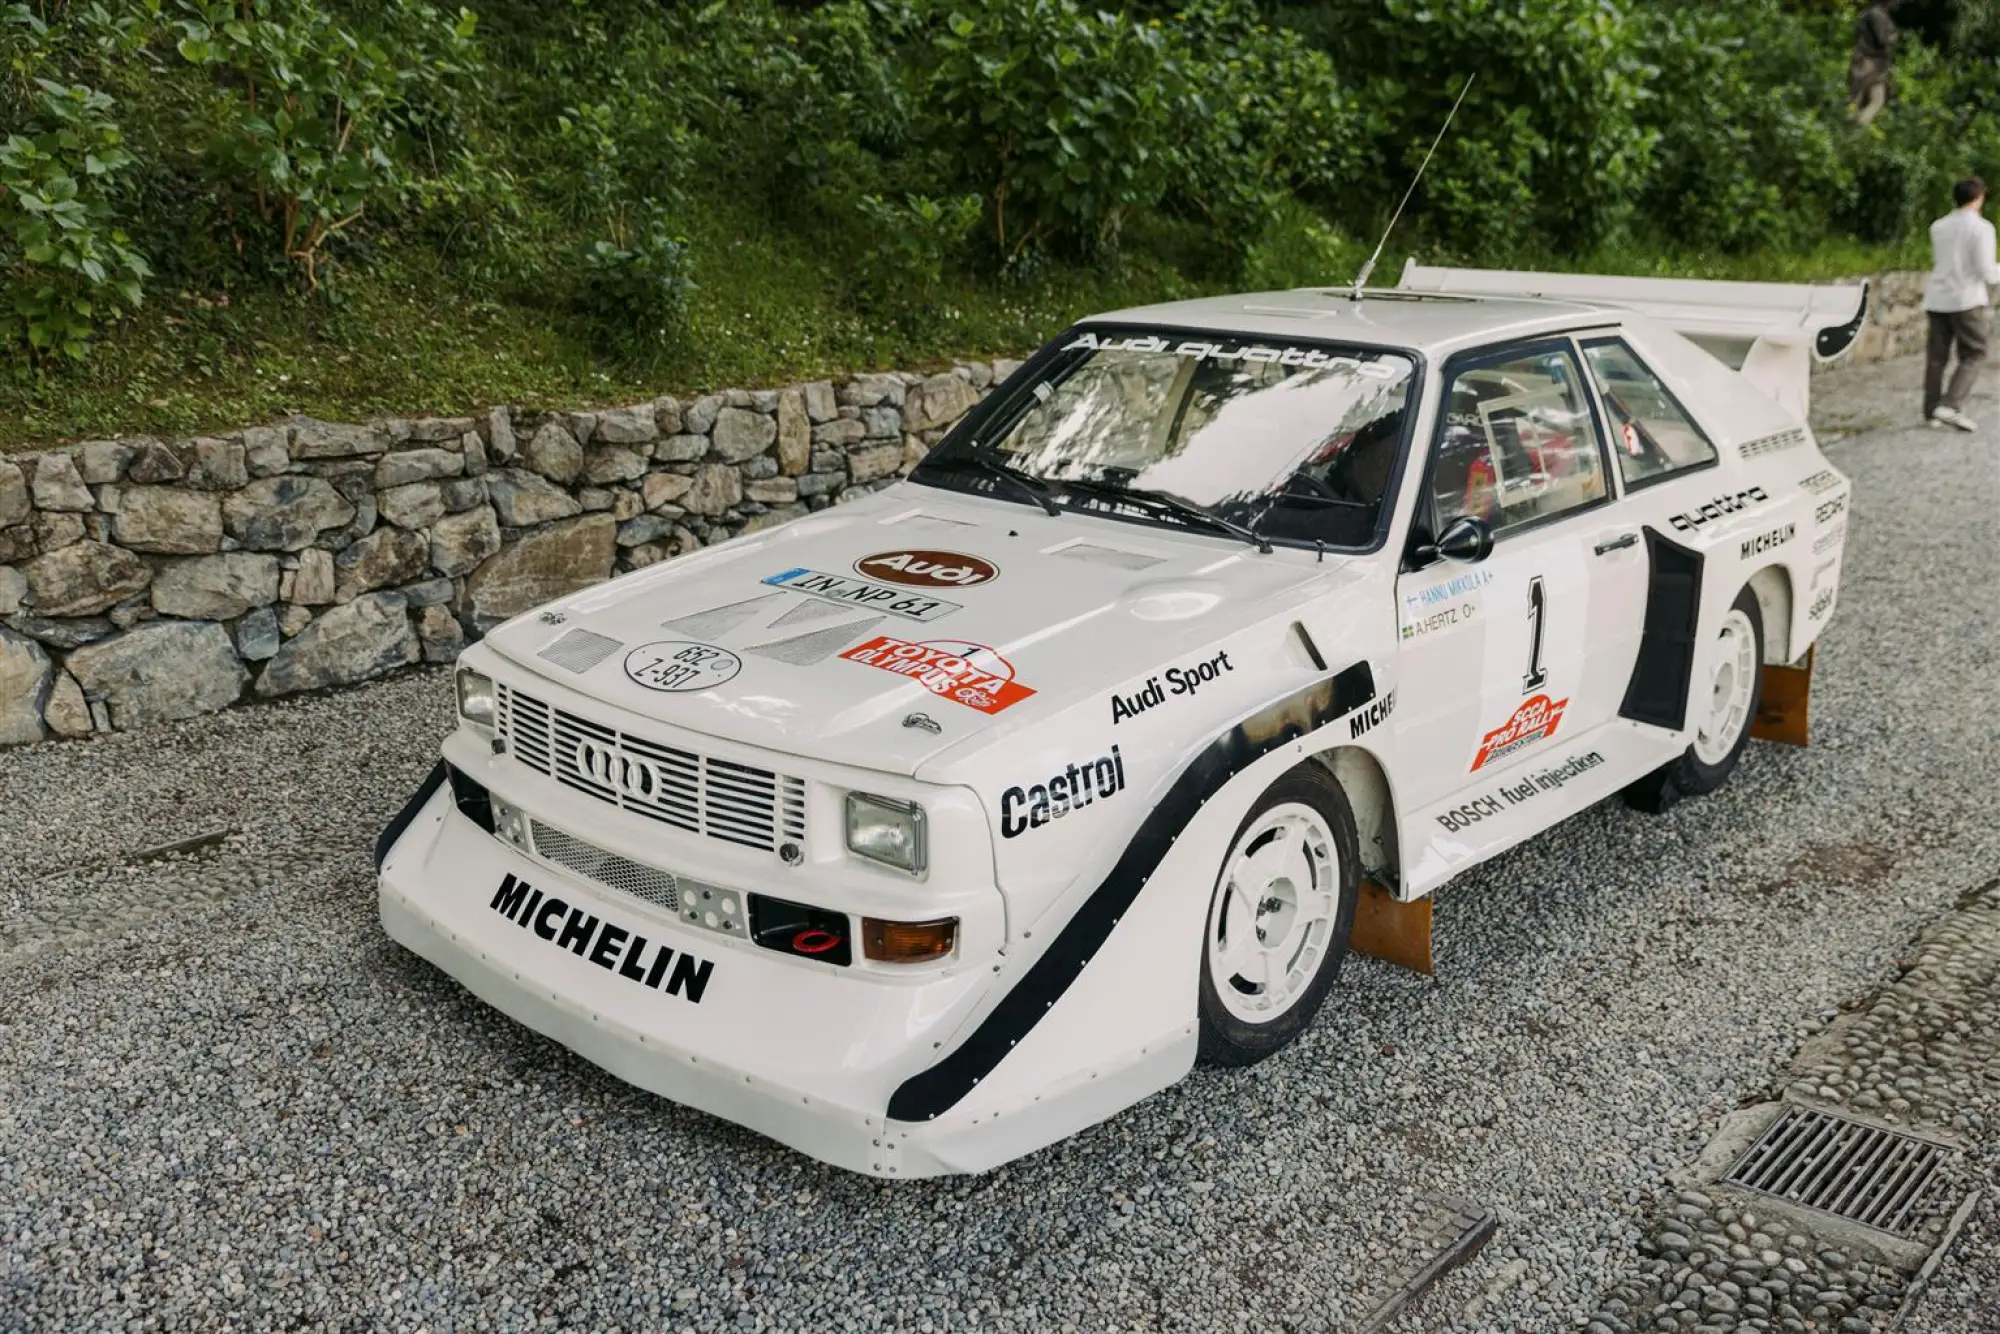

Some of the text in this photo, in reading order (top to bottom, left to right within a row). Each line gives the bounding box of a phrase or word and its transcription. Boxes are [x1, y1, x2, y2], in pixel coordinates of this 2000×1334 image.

[1061, 332, 1398, 379] Audi quattro
[1668, 486, 1769, 532] quattro
[1740, 522, 1796, 561] MICHELIN
[864, 553, 985, 585] Audi
[1419, 583, 1448, 605] HANNU
[1447, 572, 1481, 597] MIKKOLA
[791, 575, 940, 616] IN NP 61
[673, 646, 720, 666] 652
[1521, 574, 1549, 696] 1
[633, 657, 702, 689] Z-937
[849, 648, 960, 693] OLYMPUS
[874, 638, 1008, 695] TOYOTA
[1111, 650, 1236, 725] Audi Sport
[1513, 699, 1549, 724] SCCA
[1001, 745, 1126, 839] Castrol
[1435, 751, 1606, 833] BOSCH fuel injection
[490, 872, 715, 1004] MICHELIN
